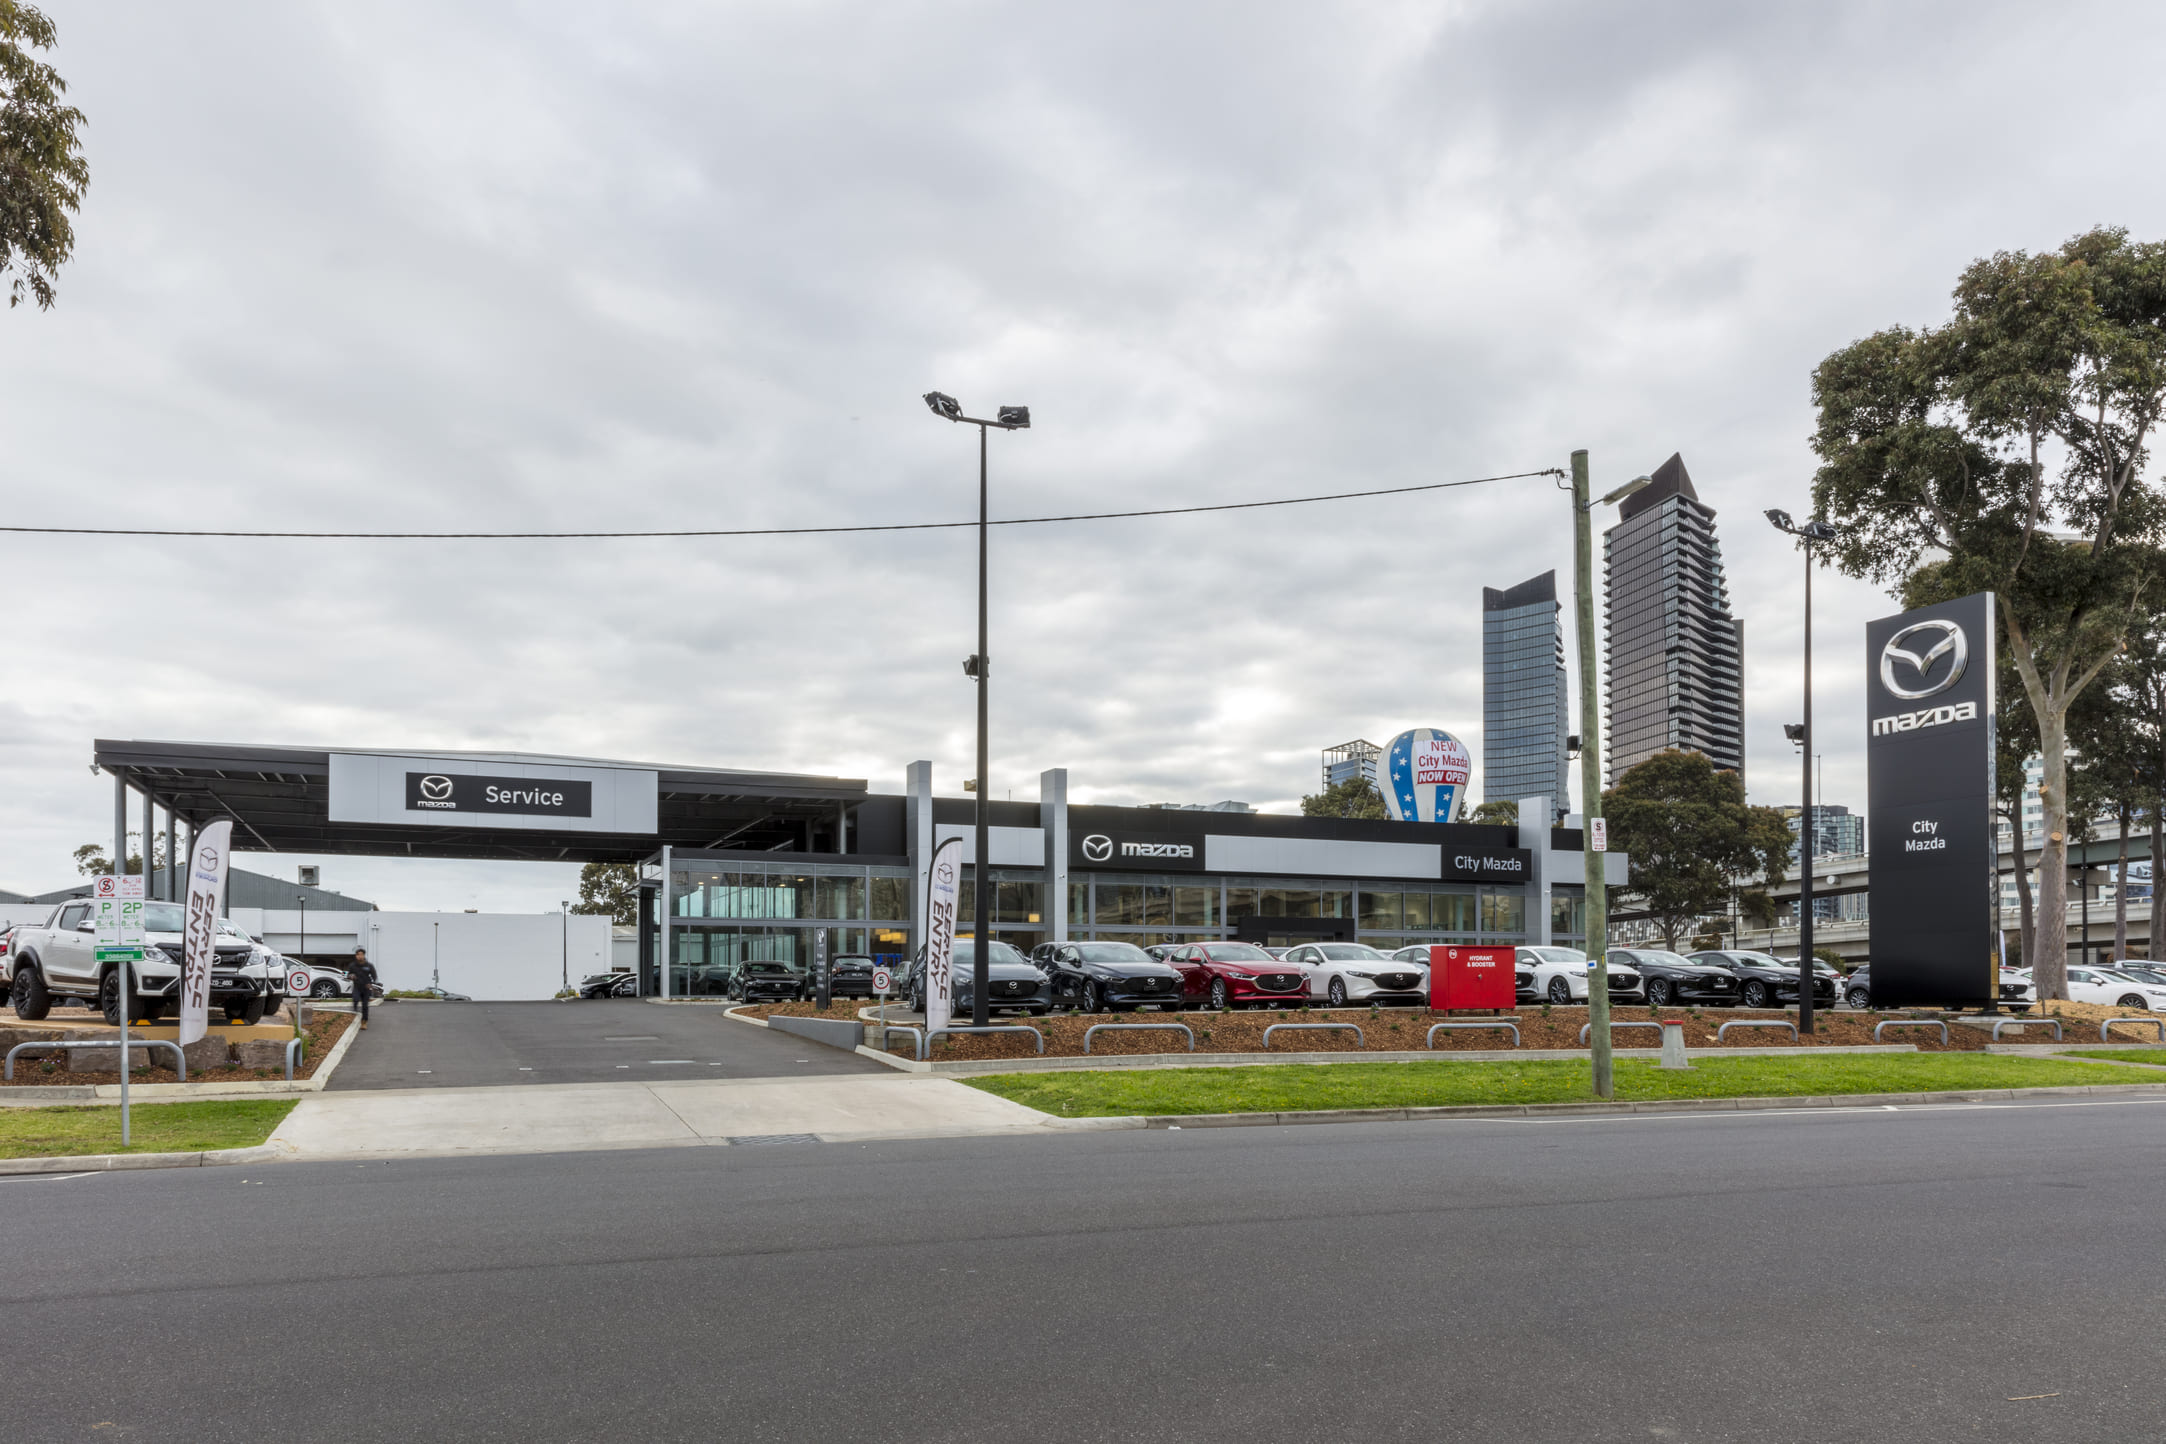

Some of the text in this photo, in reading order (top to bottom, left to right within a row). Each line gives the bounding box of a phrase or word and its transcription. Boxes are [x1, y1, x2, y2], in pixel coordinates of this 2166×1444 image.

[1431, 740, 1457, 752] NEW
[1418, 754, 1468, 769] City Mazda
[1419, 771, 1467, 784] NOW OPEN
[486, 785, 564, 806] Service
[1912, 820, 1938, 835] City
[1905, 837, 1946, 852] Mazda
[1455, 856, 1522, 873] City Mazda
[102, 902, 112, 914] P
[122, 902, 143, 914] 2P
[185, 890, 204, 996] ENTRY
[192, 889, 216, 1009] SERVICE
[930, 900, 944, 988] ENTRY
[939, 899, 953, 1001] SERVICE
[296, 976, 304, 986] 5
[878, 976, 885, 985] 5
